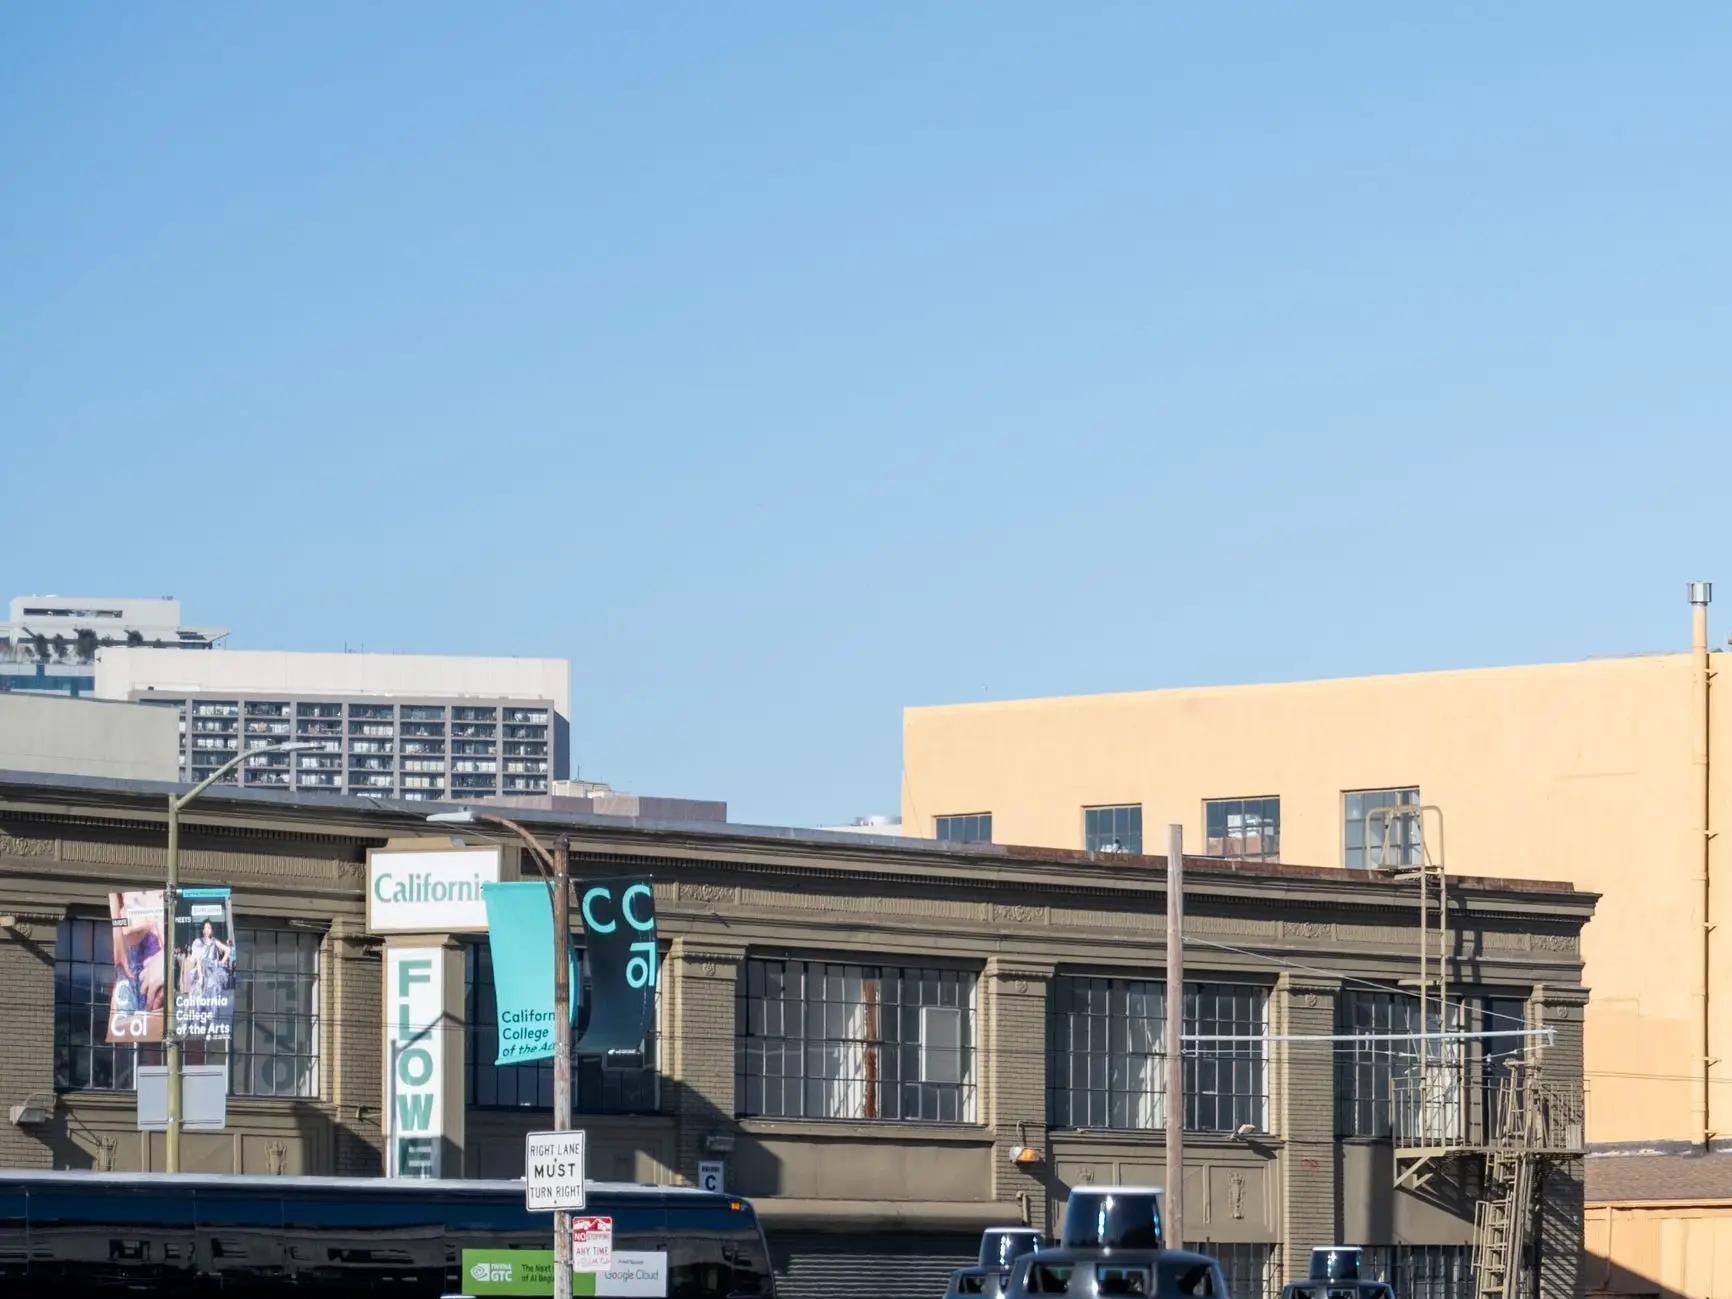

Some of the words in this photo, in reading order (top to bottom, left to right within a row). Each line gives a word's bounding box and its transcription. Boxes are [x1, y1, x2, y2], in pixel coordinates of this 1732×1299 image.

[374, 872, 485, 902] Californi
[175, 995, 228, 1007] California
[175, 1010, 213, 1023] College
[502, 1009, 556, 1023] Californ
[175, 1024, 188, 1035] of
[188, 1024, 206, 1035] the
[207, 1023, 230, 1034] Arts
[503, 1027, 549, 1041] College
[503, 1044, 516, 1057] of
[518, 1043, 538, 1055] the
[530, 1144, 555, 1157] RIGHT
[557, 1143, 580, 1155] LANE
[534, 1163, 576, 1179] MUST
[704, 1174, 716, 1192] C
[530, 1186, 552, 1199] TURN
[556, 1185, 581, 1198] RIGHT
[574, 1232, 586, 1241] NO
[576, 1246, 590, 1256] ANY
[592, 1246, 609, 1256] TIME
[521, 1263, 534, 1273] The
[535, 1264, 551, 1273] Next
[490, 1270, 513, 1282] GTC
[521, 1274, 530, 1282] of
[605, 1269, 635, 1281] Google
[635, 1270, 659, 1281] Cloud
